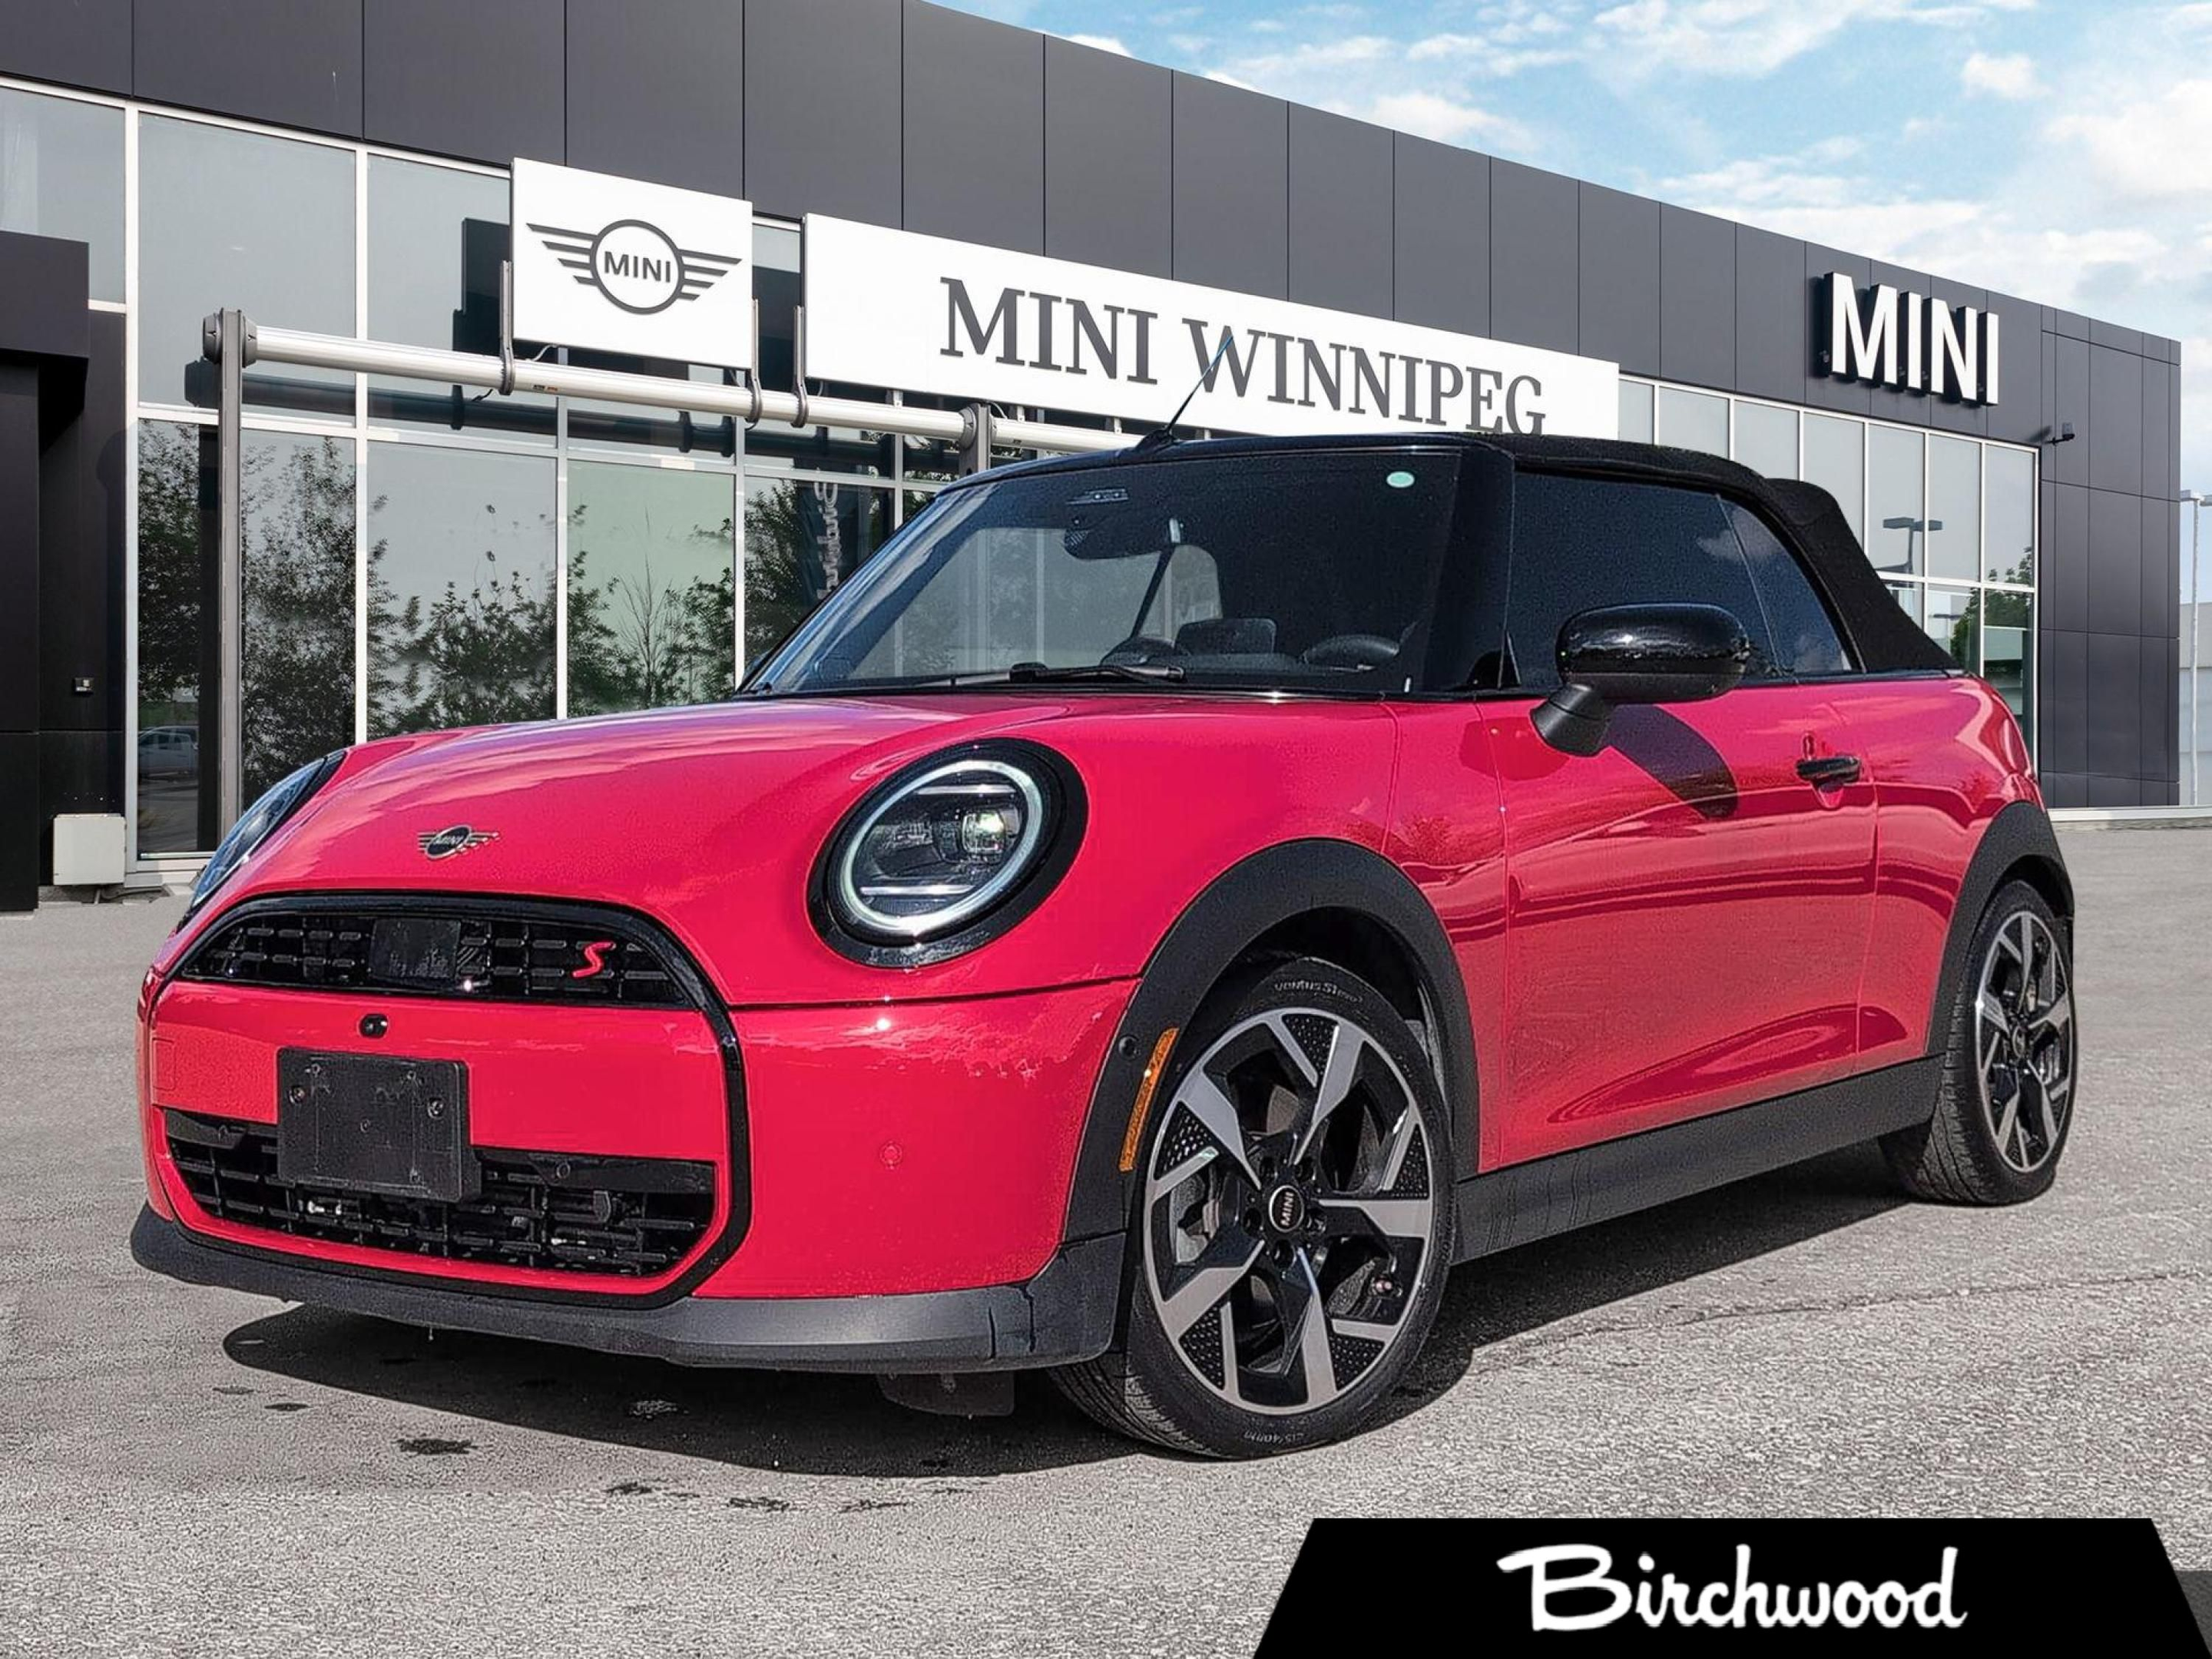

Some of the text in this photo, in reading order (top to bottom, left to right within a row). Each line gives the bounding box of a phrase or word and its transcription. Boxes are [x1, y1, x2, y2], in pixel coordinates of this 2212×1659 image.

[604, 250, 671, 283] MINI
[939, 276, 1547, 435] MINI WINNIPEG
[1825, 271, 1999, 406] MINI
[571, 941, 617, 979] S
[1280, 1191, 1295, 1227] MINI
